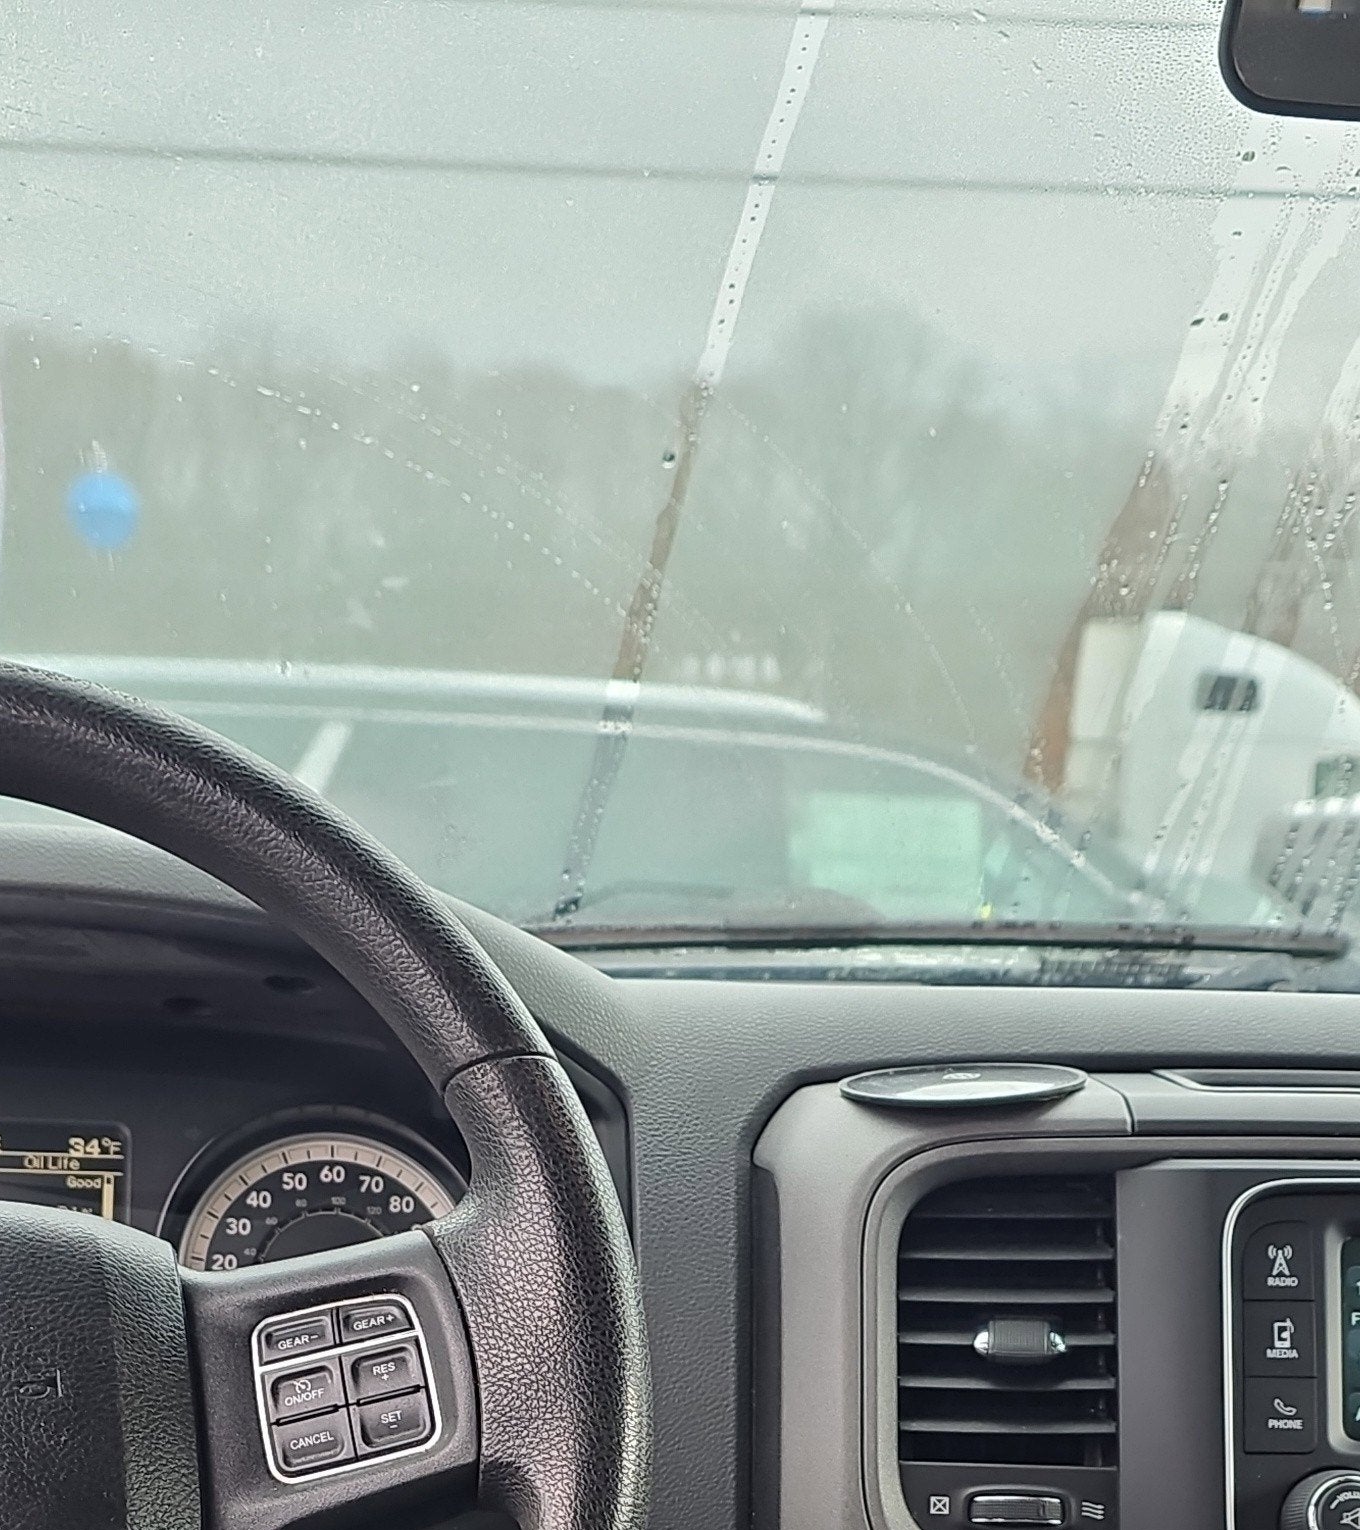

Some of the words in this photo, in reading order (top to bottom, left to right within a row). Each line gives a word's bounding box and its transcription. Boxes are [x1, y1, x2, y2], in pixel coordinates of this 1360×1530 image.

[23, 1155, 44, 1169] Oil
[47, 1156, 81, 1170] Life
[66, 1175, 102, 1189] Good
[282, 1172, 307, 1191] 50
[319, 1165, 345, 1183] 60
[359, 1174, 384, 1193] 70
[246, 1190, 272, 1209] 40
[389, 1195, 415, 1213] 80
[225, 1217, 251, 1236] 30
[212, 1254, 238, 1271] 20
[1266, 1276, 1299, 1287] RADIO
[1266, 1348, 1299, 1359] MEDIA
[372, 1362, 396, 1376] RES
[284, 1387, 325, 1407] ON/OFF
[380, 1410, 403, 1424] SET
[1268, 1419, 1303, 1430] PHONE
[290, 1430, 335, 1451] CANCEL
